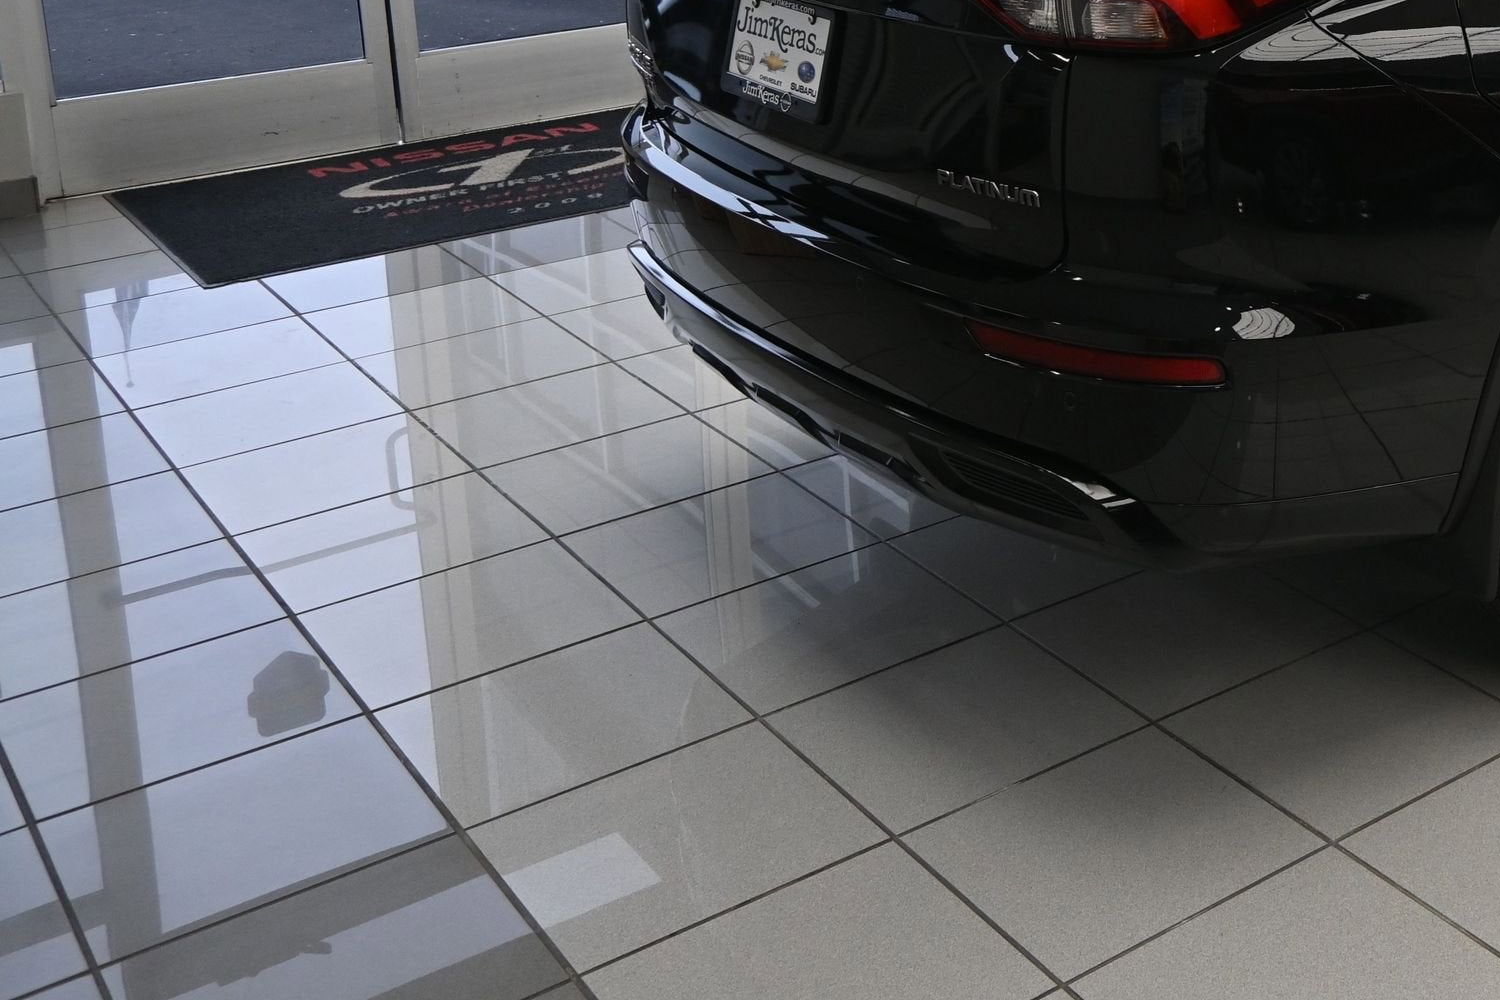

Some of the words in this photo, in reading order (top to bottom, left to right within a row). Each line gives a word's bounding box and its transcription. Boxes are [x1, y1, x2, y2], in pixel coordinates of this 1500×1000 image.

[759, 74, 783, 87] CHEVROLET
[790, 82, 817, 98] SUBARU
[308, 122, 600, 178] NISSAN
[352, 188, 469, 214] OWNER
[478, 171, 561, 191] FIRST
[937, 168, 1040, 208] PLATINUM
